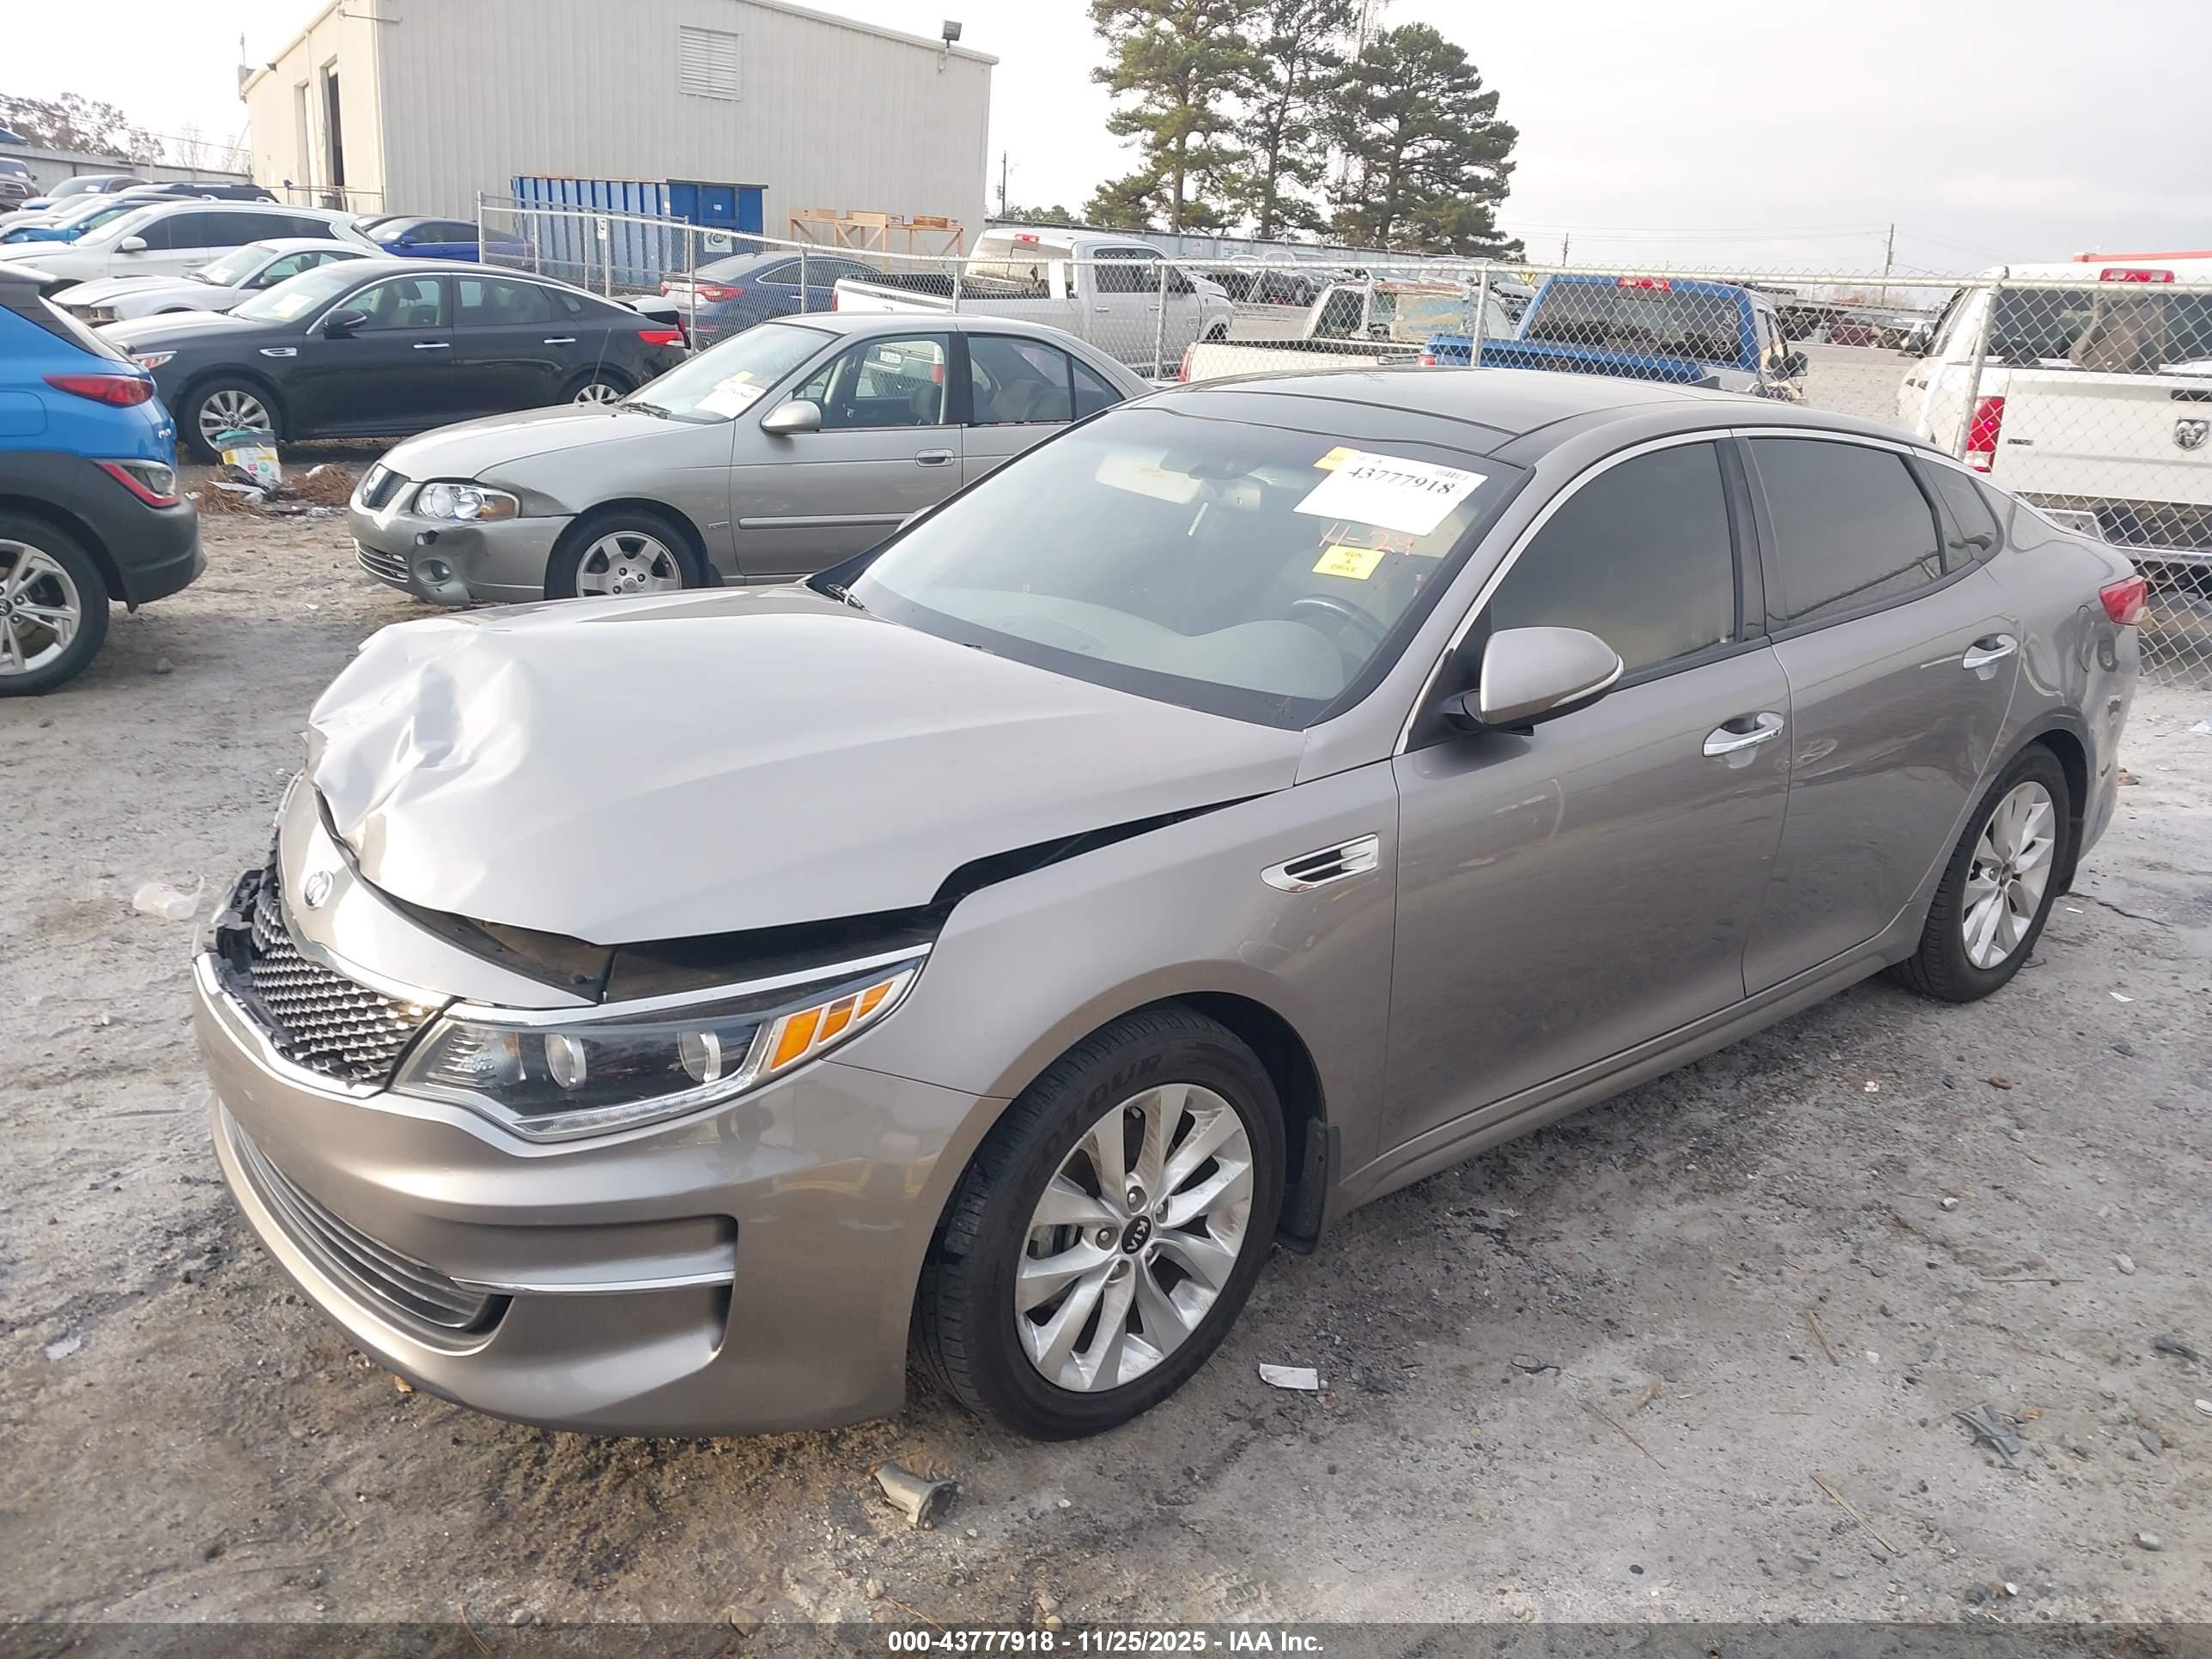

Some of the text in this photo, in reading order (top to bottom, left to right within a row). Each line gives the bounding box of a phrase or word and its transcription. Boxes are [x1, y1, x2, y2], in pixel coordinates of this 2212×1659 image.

[1348, 466, 1455, 495] 43777918
[1330, 563, 1358, 572] DRIVE
[1126, 1219, 1148, 1250] KIA
